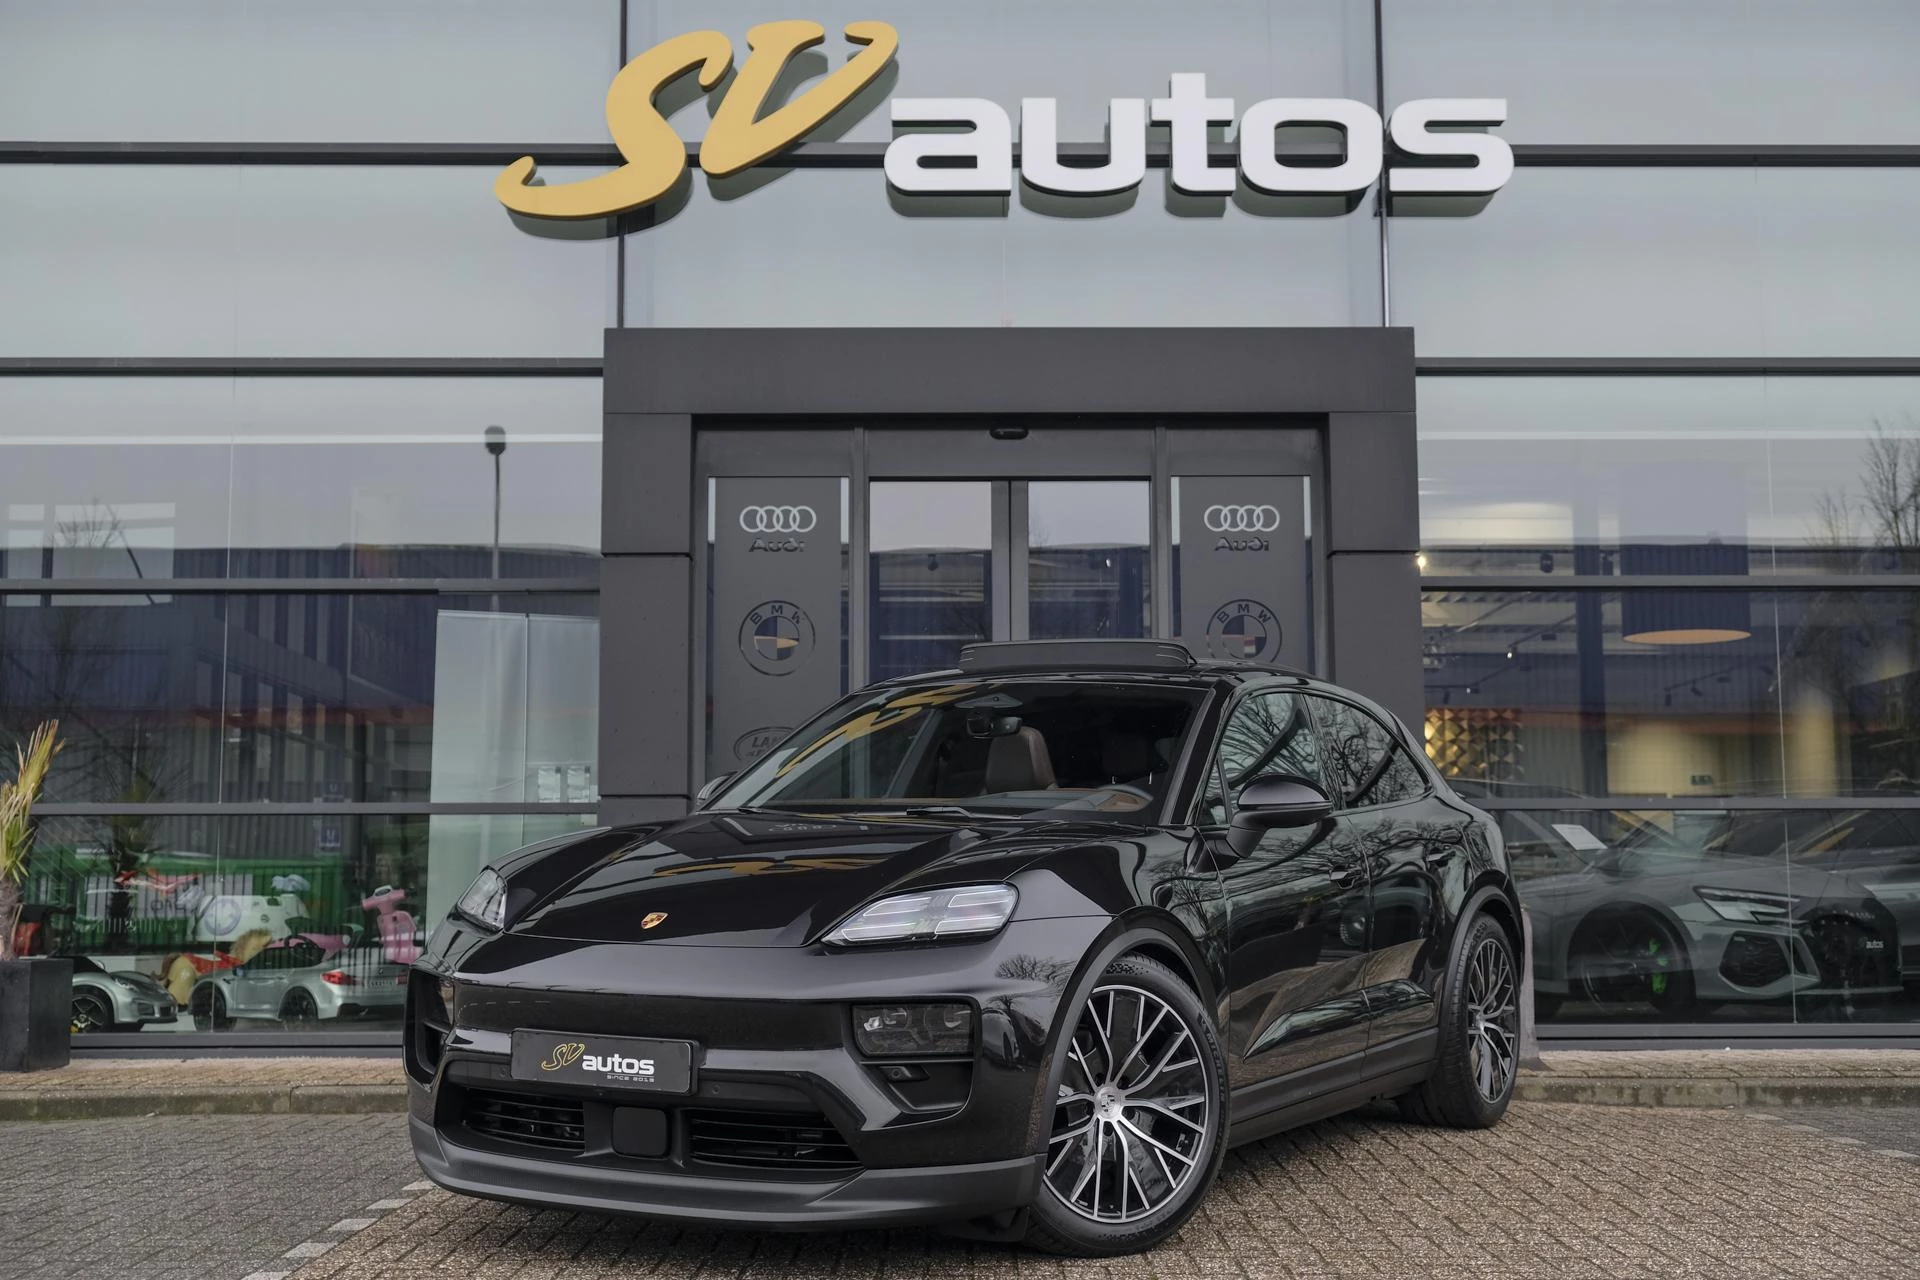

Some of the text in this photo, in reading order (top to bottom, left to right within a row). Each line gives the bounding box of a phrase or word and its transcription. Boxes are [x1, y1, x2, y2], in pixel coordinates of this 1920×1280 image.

[493, 19, 1517, 221] SV autos
[748, 537, 806, 553] Audi
[1214, 536, 1270, 552] Audi
[750, 604, 804, 625] BMW
[1217, 603, 1272, 624] BMW
[541, 1042, 655, 1075] SV autos
